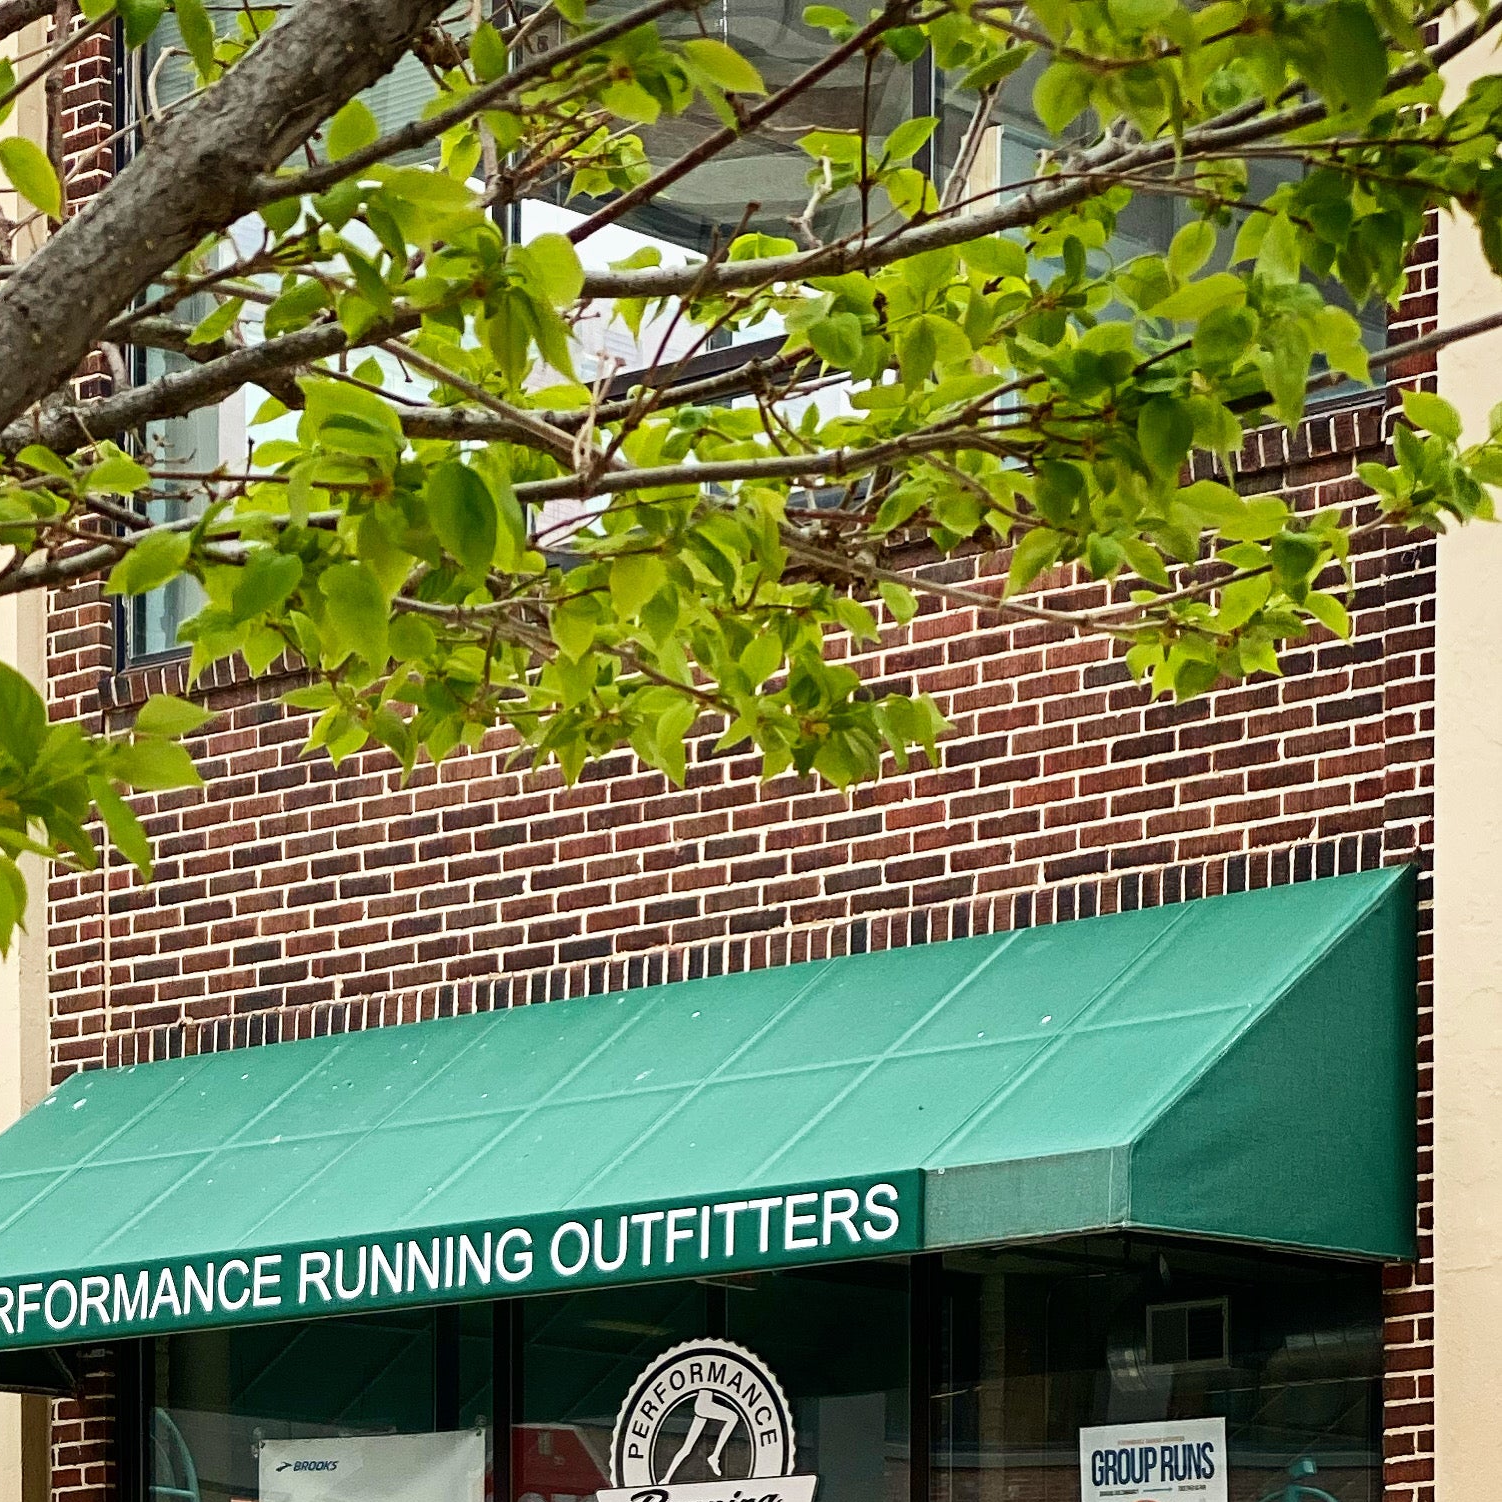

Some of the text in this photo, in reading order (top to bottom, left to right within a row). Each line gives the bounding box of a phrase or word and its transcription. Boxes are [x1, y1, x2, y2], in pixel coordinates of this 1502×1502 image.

[298, 1228, 533, 1303] RUNNING
[550, 1184, 899, 1277] OUTFITTERS
[628, 1361, 778, 1459] PERFORMANCE
[293, 1461, 339, 1471] BROOKS
[1091, 1442, 1215, 1486] GROUP RUNS
